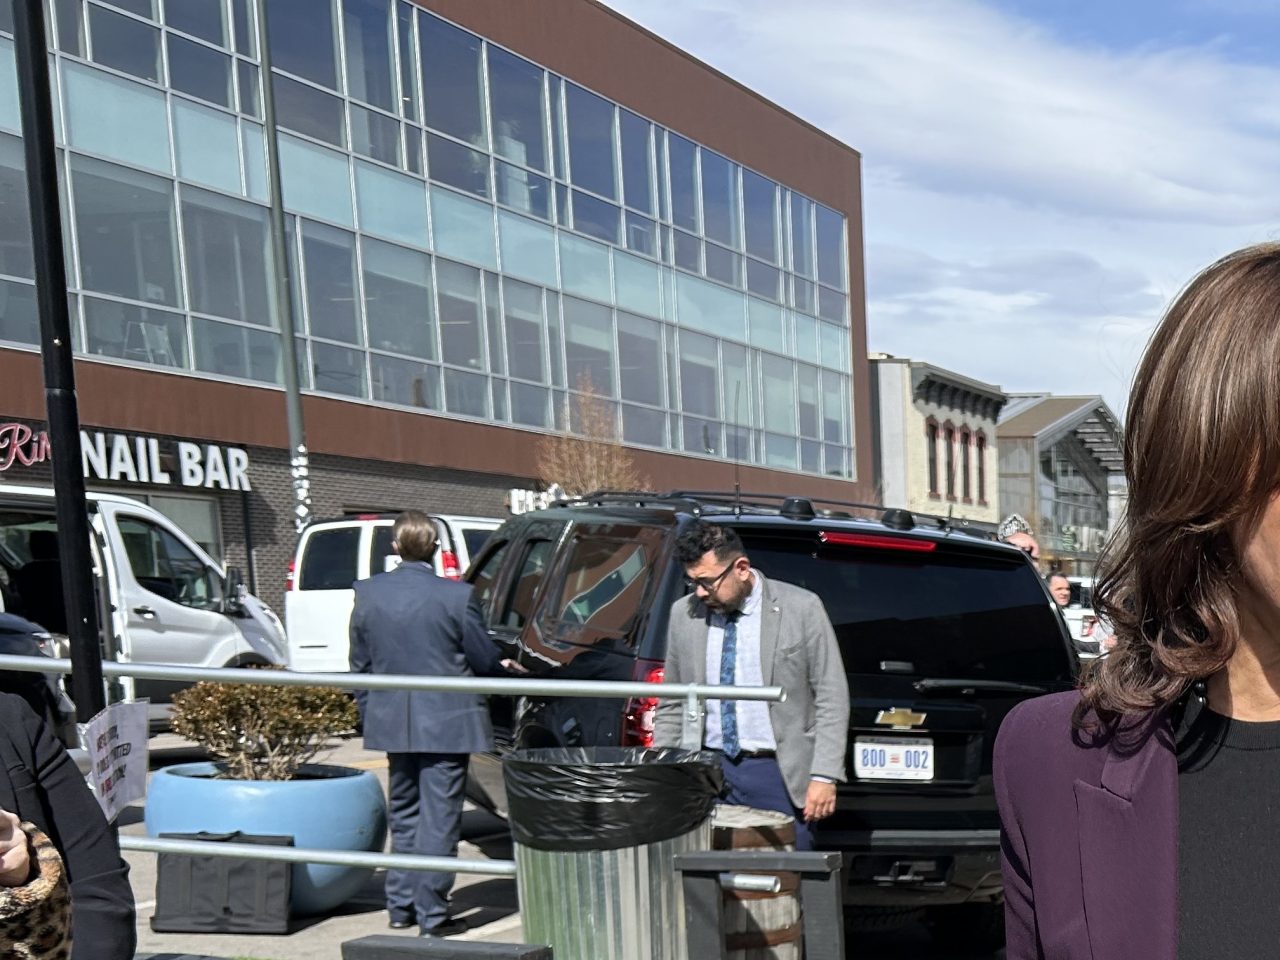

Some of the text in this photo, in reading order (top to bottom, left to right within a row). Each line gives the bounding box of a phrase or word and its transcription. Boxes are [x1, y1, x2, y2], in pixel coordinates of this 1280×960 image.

[80, 430, 171, 485] NAIL
[178, 440, 252, 492] BAR
[862, 748, 928, 769] 800 002
